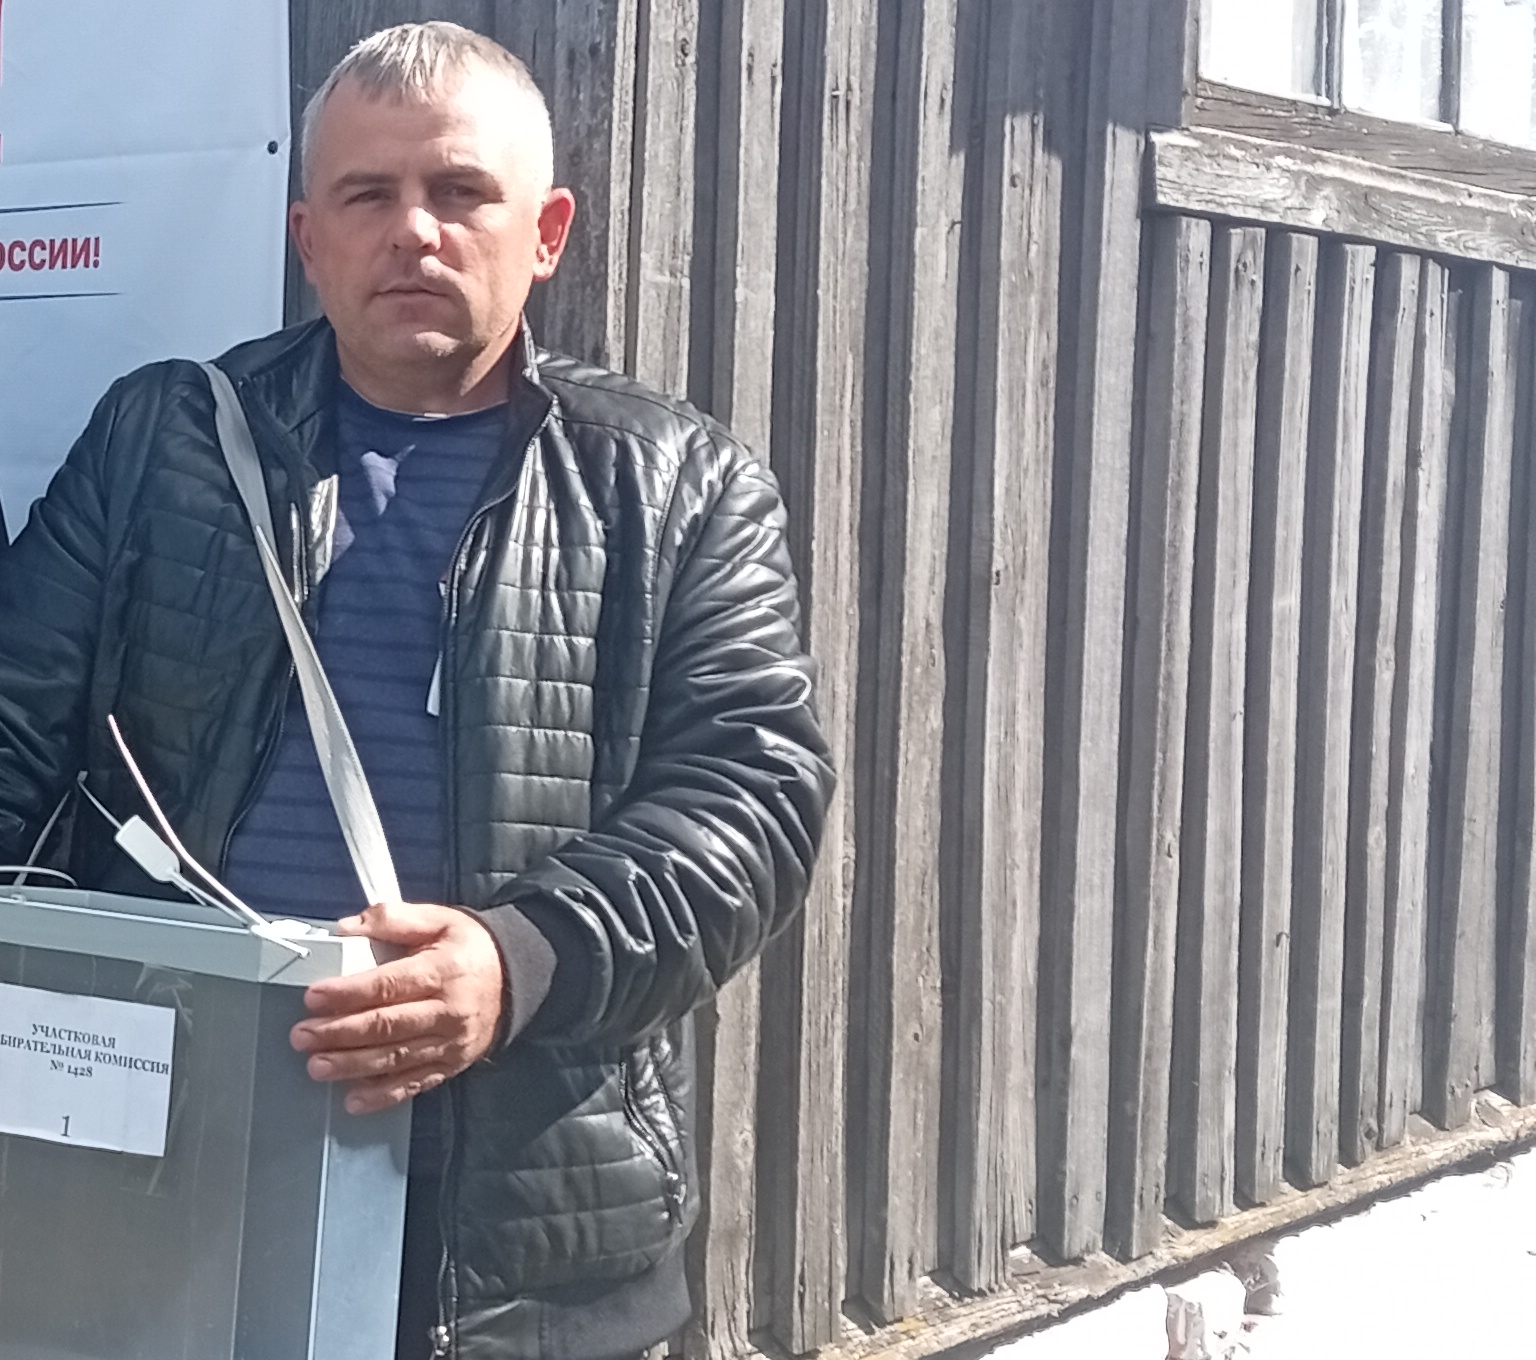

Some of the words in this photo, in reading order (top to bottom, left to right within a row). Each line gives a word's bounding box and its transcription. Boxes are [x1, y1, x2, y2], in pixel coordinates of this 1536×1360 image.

[32, 1023, 116, 1049] УЧАСТКОВАЯ
[67, 1066, 93, 1078] 1428
[94, 1051, 170, 1075] КОМИССИЯ
[60, 1115, 70, 1137] 1
